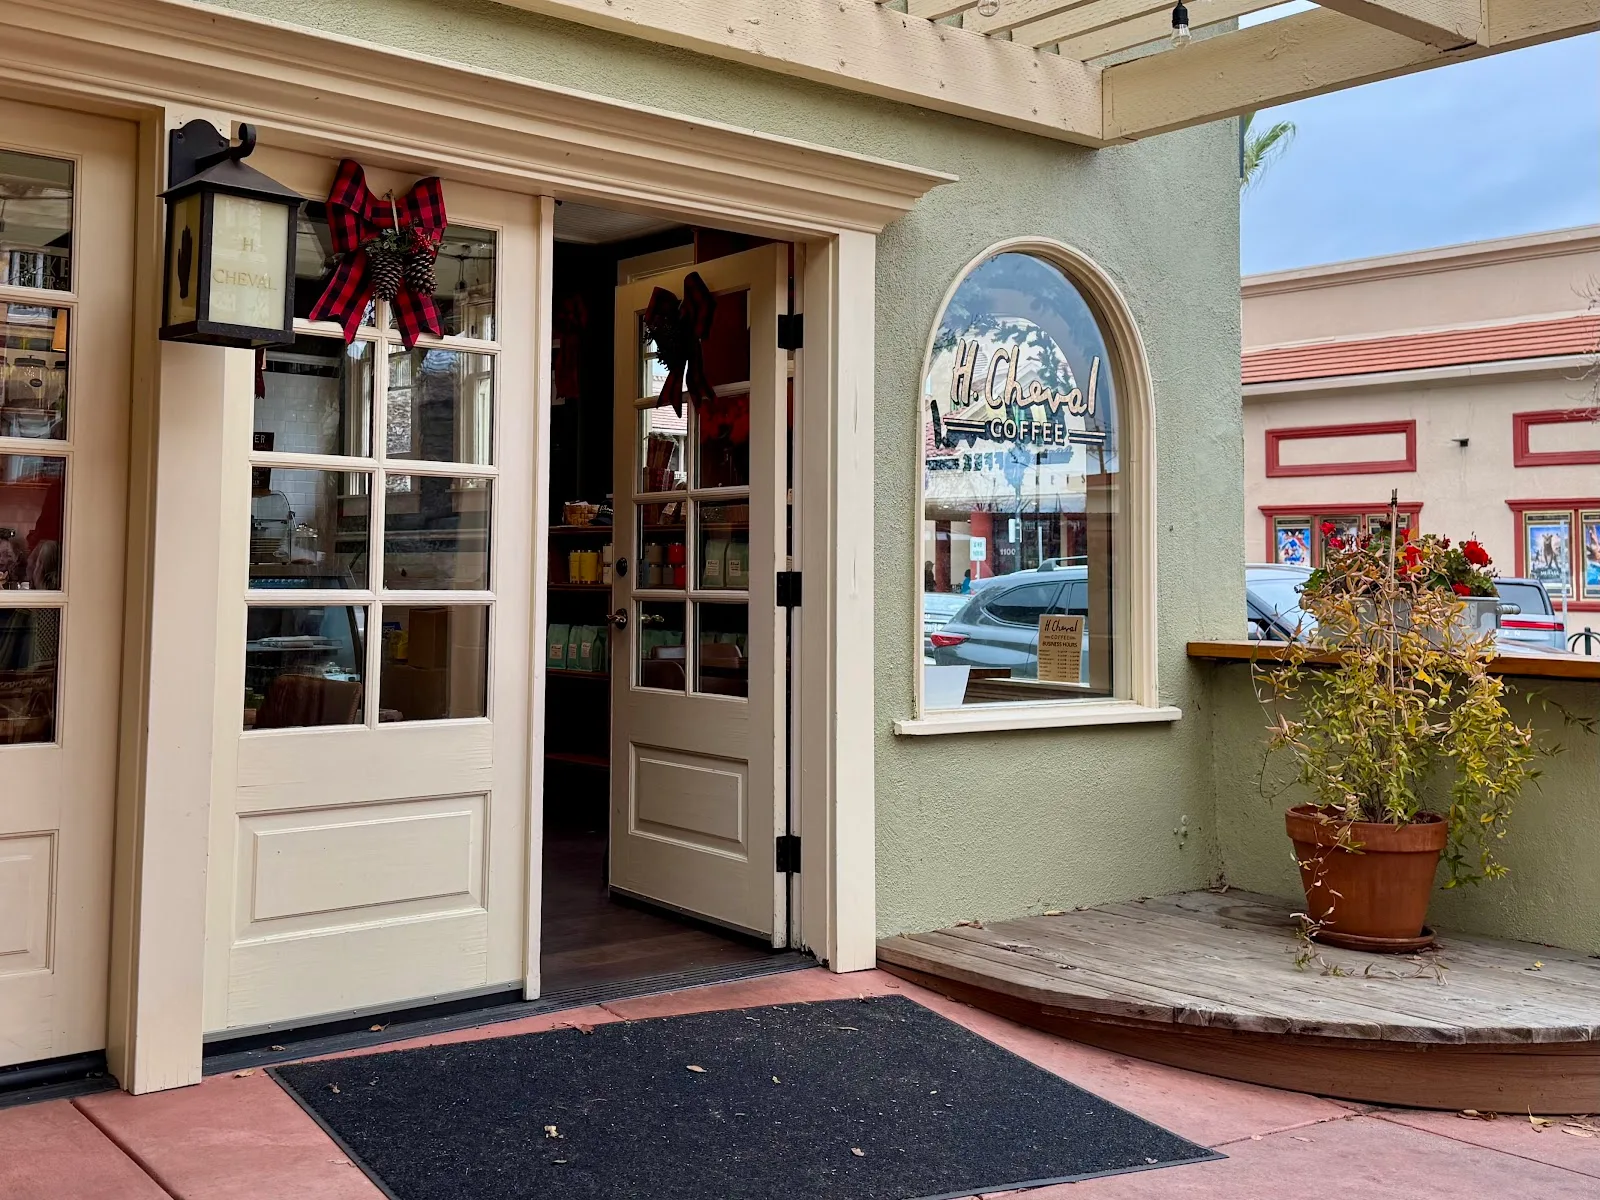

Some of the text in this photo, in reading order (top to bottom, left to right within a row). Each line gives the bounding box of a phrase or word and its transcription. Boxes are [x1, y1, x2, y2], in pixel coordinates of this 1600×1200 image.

[212, 269, 278, 291] CHEVAL
[950, 338, 1100, 418] H. Cheval
[990, 418, 1065, 446] COFFEE
[999, 548, 1016, 556] 1100
